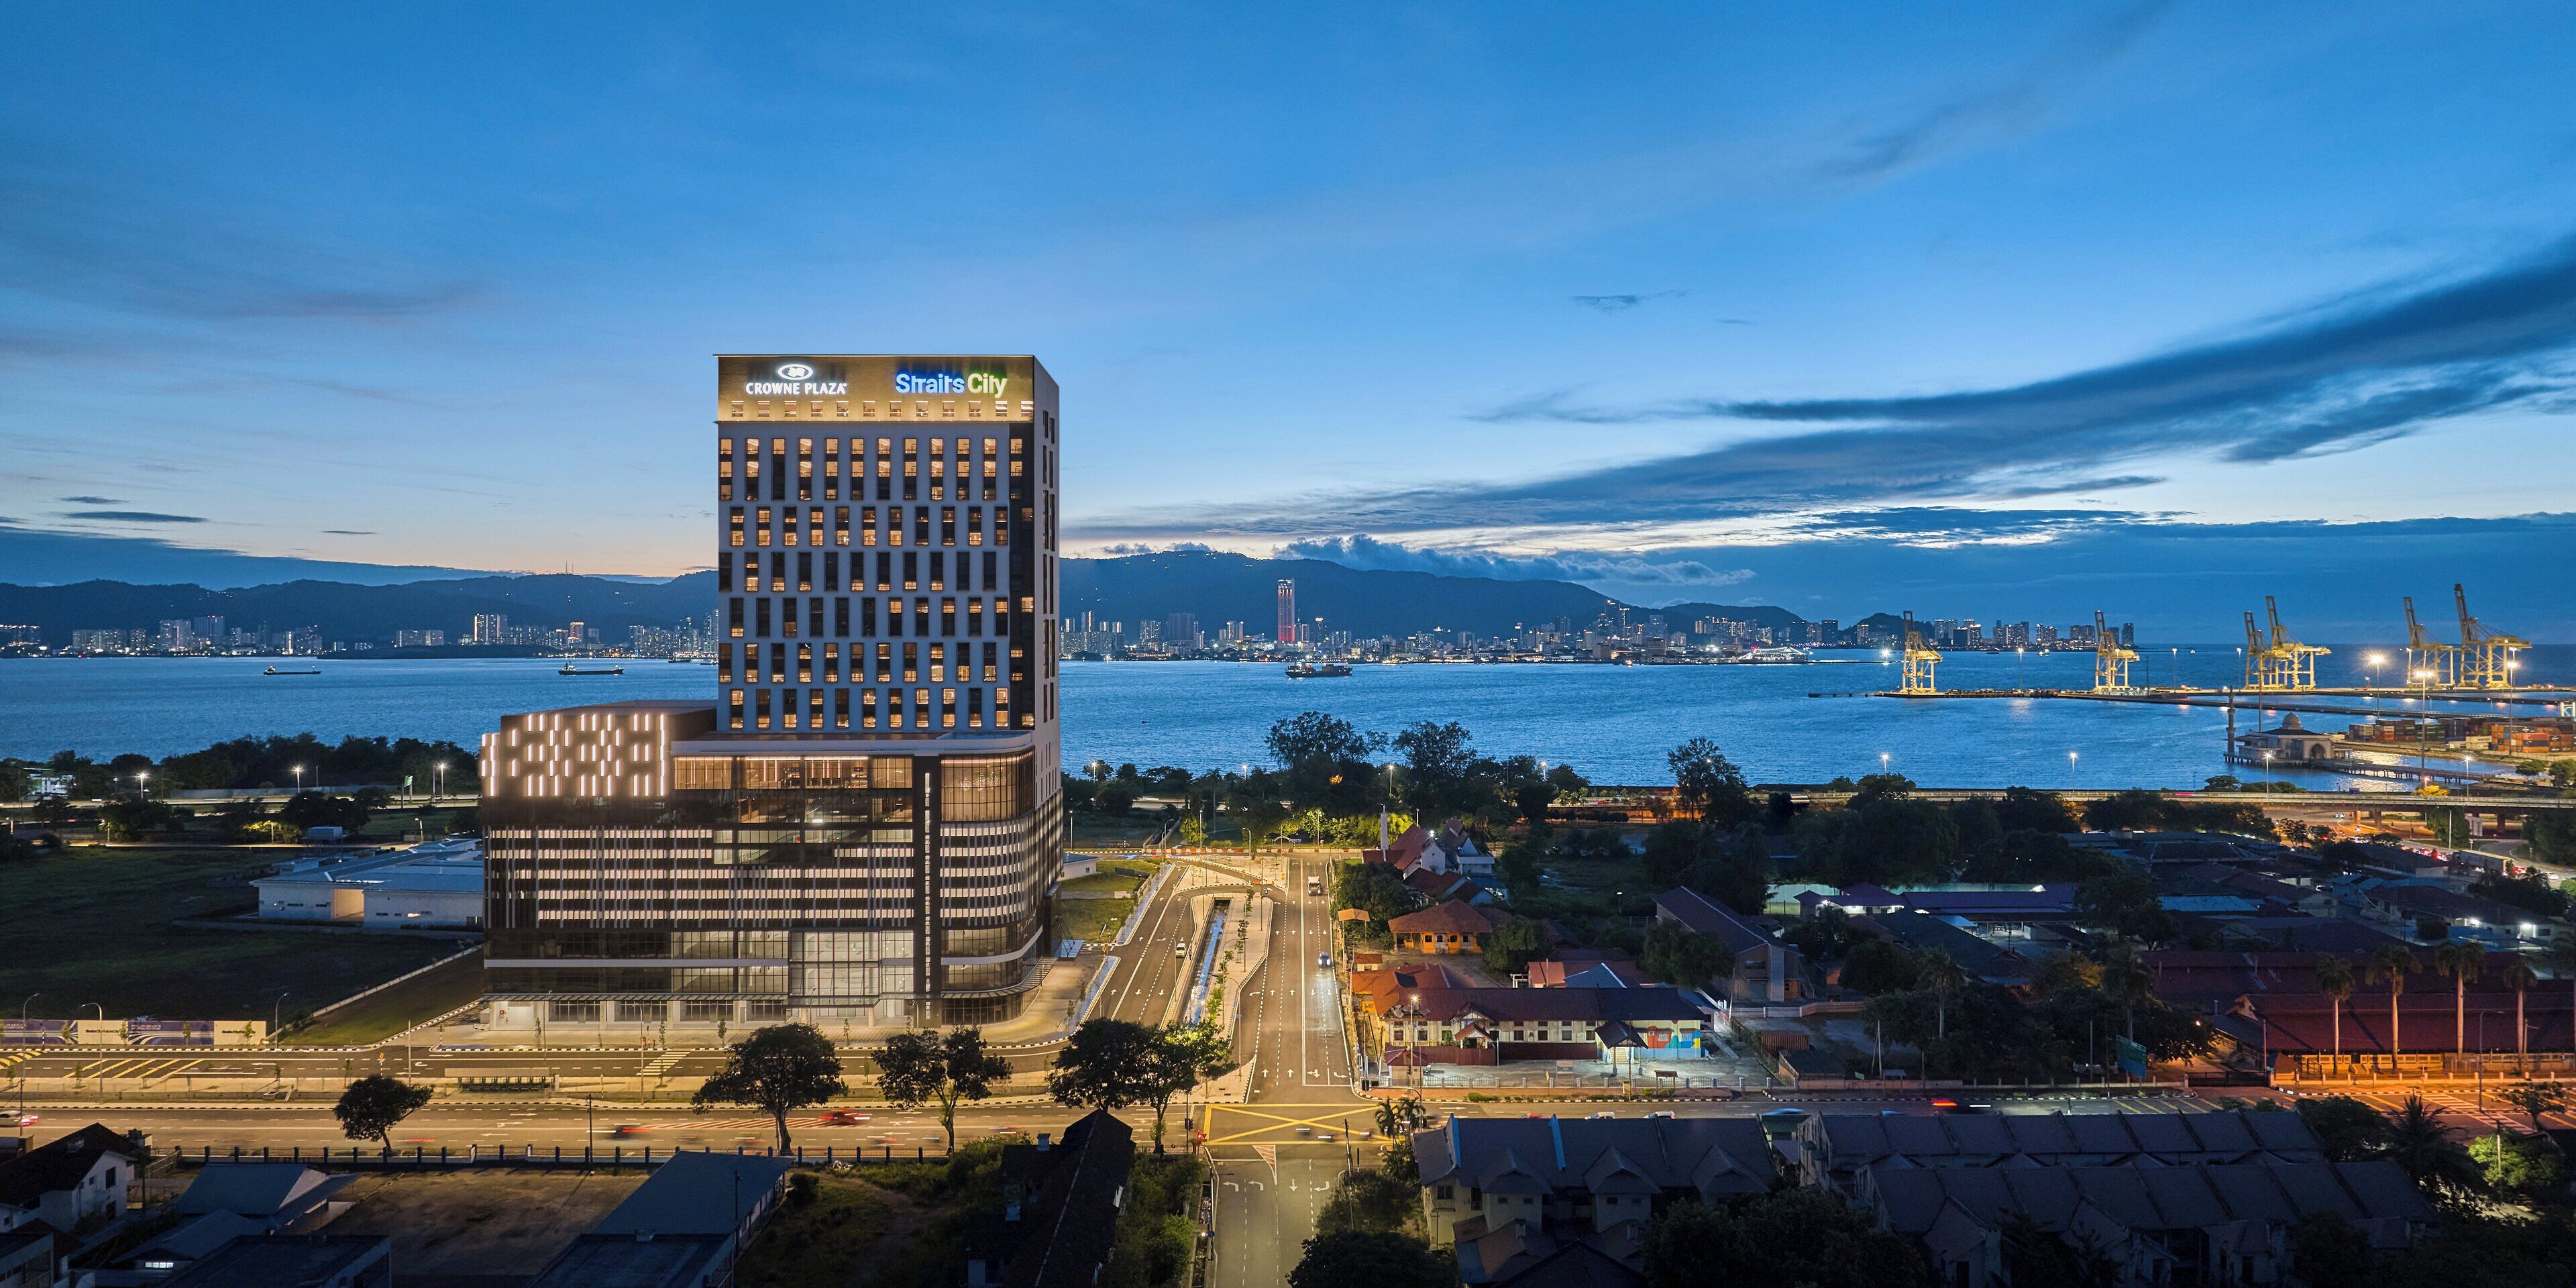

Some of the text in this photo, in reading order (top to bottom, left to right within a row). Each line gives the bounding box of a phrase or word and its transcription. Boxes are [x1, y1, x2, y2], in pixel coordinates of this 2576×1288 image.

[745, 382, 800, 394] CROWNE
[896, 373, 1008, 398] Straits City
